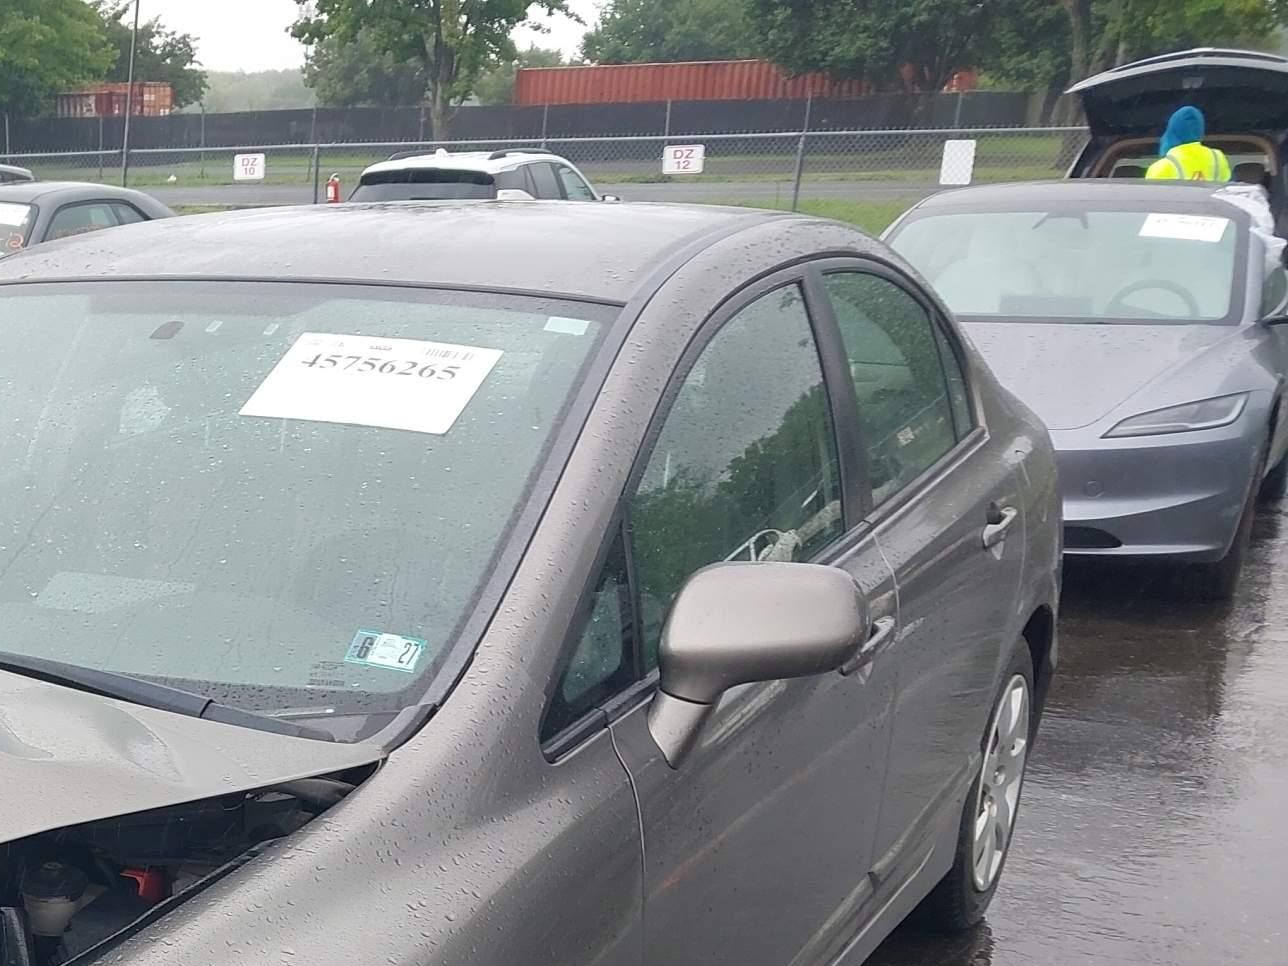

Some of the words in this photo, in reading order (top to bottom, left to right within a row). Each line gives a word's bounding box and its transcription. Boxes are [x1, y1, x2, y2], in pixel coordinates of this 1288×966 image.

[673, 149, 695, 160] DZ
[241, 157, 257, 167] DZ
[676, 160, 691, 170] 12
[244, 167, 256, 176] 10
[301, 353, 461, 381] 45756265
[398, 642, 419, 666] 27
